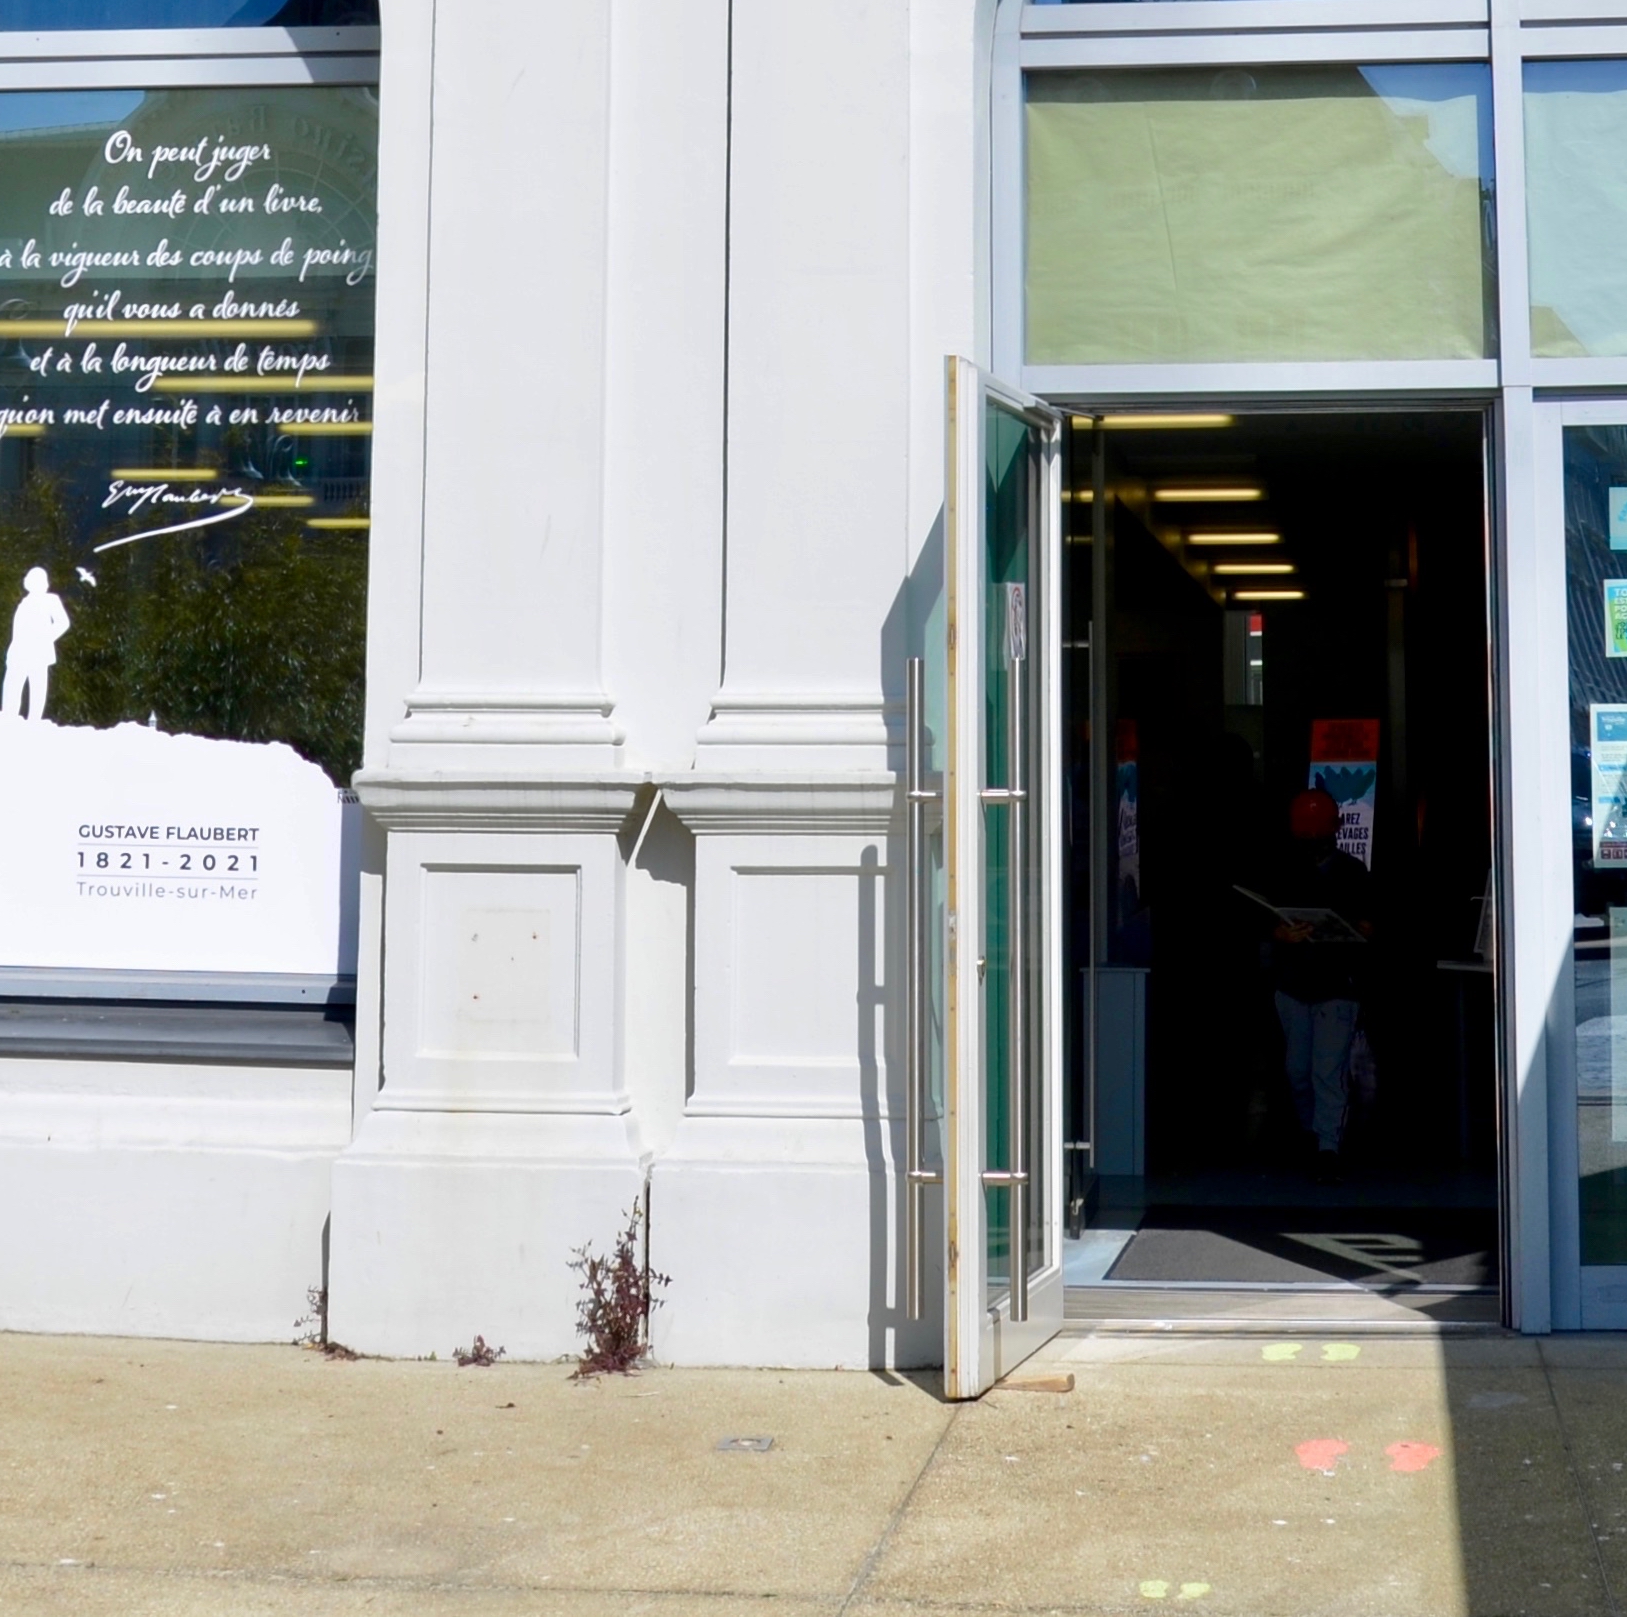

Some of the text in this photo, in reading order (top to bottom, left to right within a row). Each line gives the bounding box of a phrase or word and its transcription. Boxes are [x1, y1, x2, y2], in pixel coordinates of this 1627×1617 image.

[105, 130, 271, 182] On peut juger
[49, 183, 322, 219] de la beauté d'un livre,
[20, 238, 42, 268] la
[48, 242, 140, 288] vigueur
[146, 238, 183, 267] des
[189, 246, 264, 283] coups
[270, 236, 294, 265] de
[298, 239, 373, 286] poing
[122, 302, 182, 320] vous
[188, 303, 205, 319] a
[212, 289, 300, 320] donnés
[30, 347, 54, 377] et
[56, 352, 73, 372] à
[80, 342, 102, 373] la
[111, 342, 217, 393] longueur
[223, 342, 249, 372] de
[257, 349, 331, 387] temps
[62, 398, 112, 429] met
[112, 398, 199, 429] ensuite
[205, 404, 222, 425] à
[229, 407, 260, 424] en
[265, 399, 360, 425] revenir
[78, 824, 260, 842] GUSTAVE FLAUBERT
[1337, 827, 1369, 840] EVAGES
[76, 881, 258, 900] Trouville-sur-Mer
